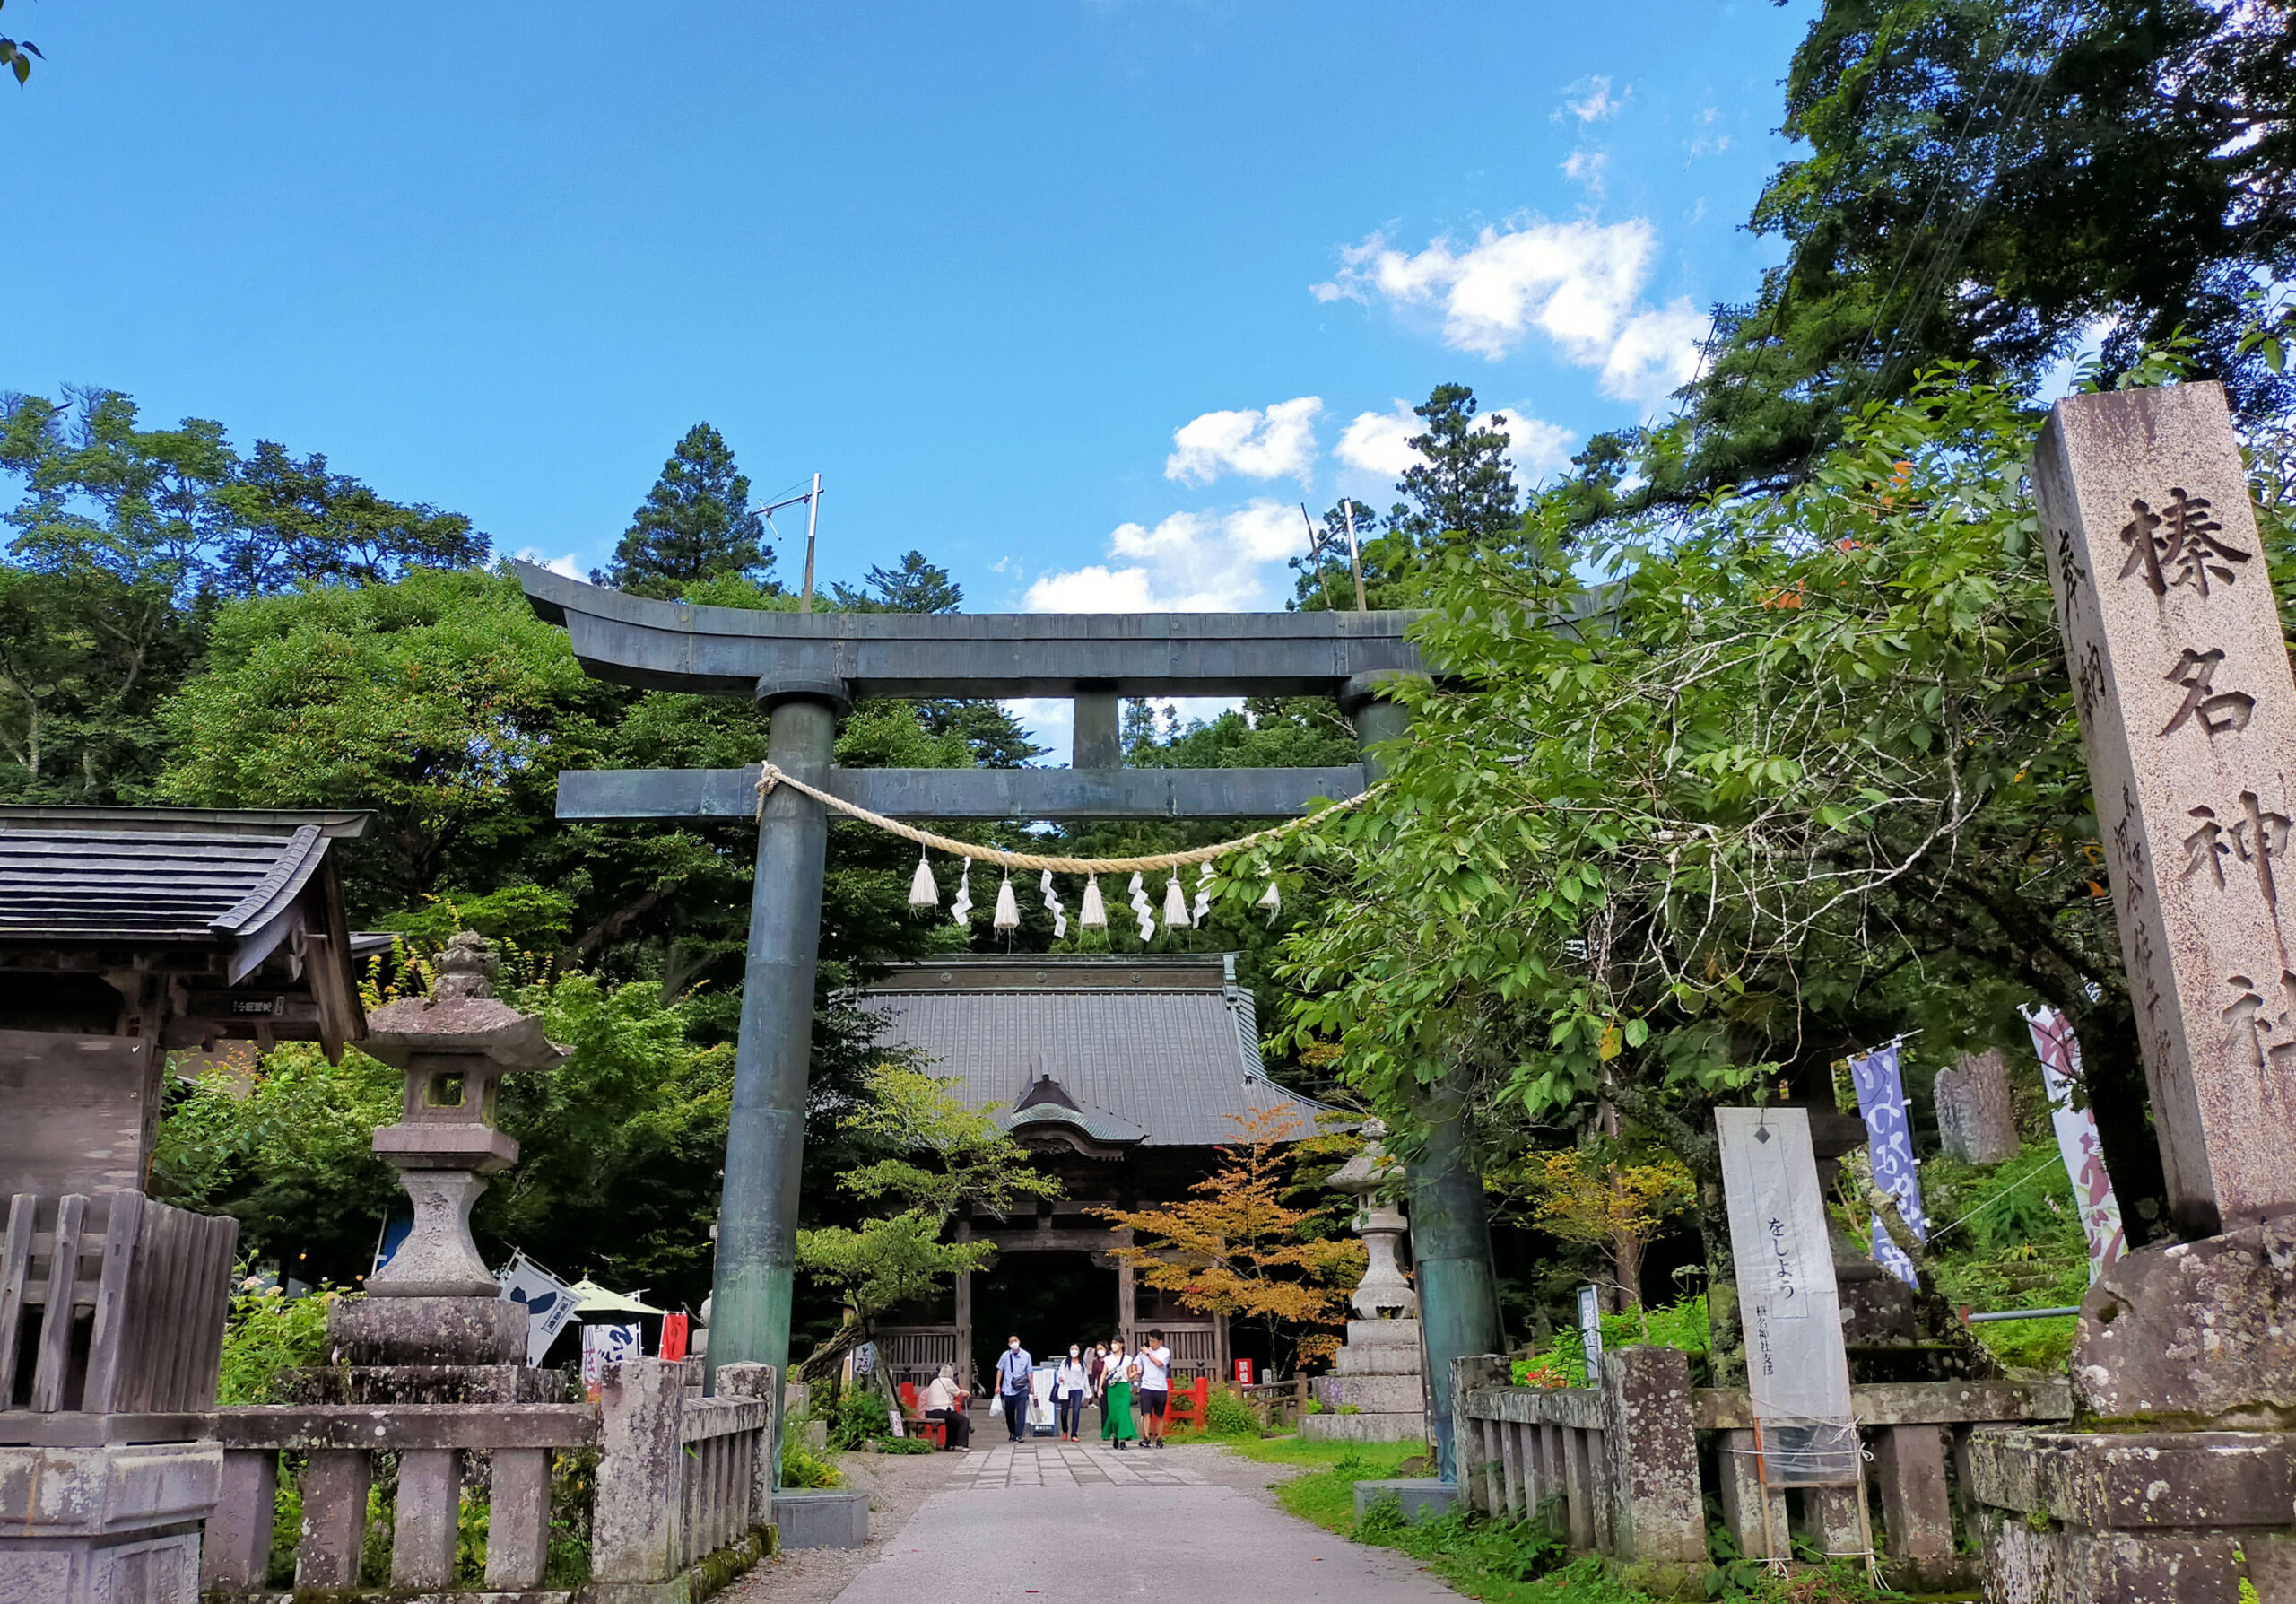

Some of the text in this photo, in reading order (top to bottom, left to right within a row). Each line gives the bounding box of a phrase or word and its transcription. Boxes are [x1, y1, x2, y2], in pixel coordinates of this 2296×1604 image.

[2118, 486, 2296, 1068] 榛名神社
[1767, 1216, 1795, 1300] をしよう
[1239, 1361, 1249, 1382] 禁煙
